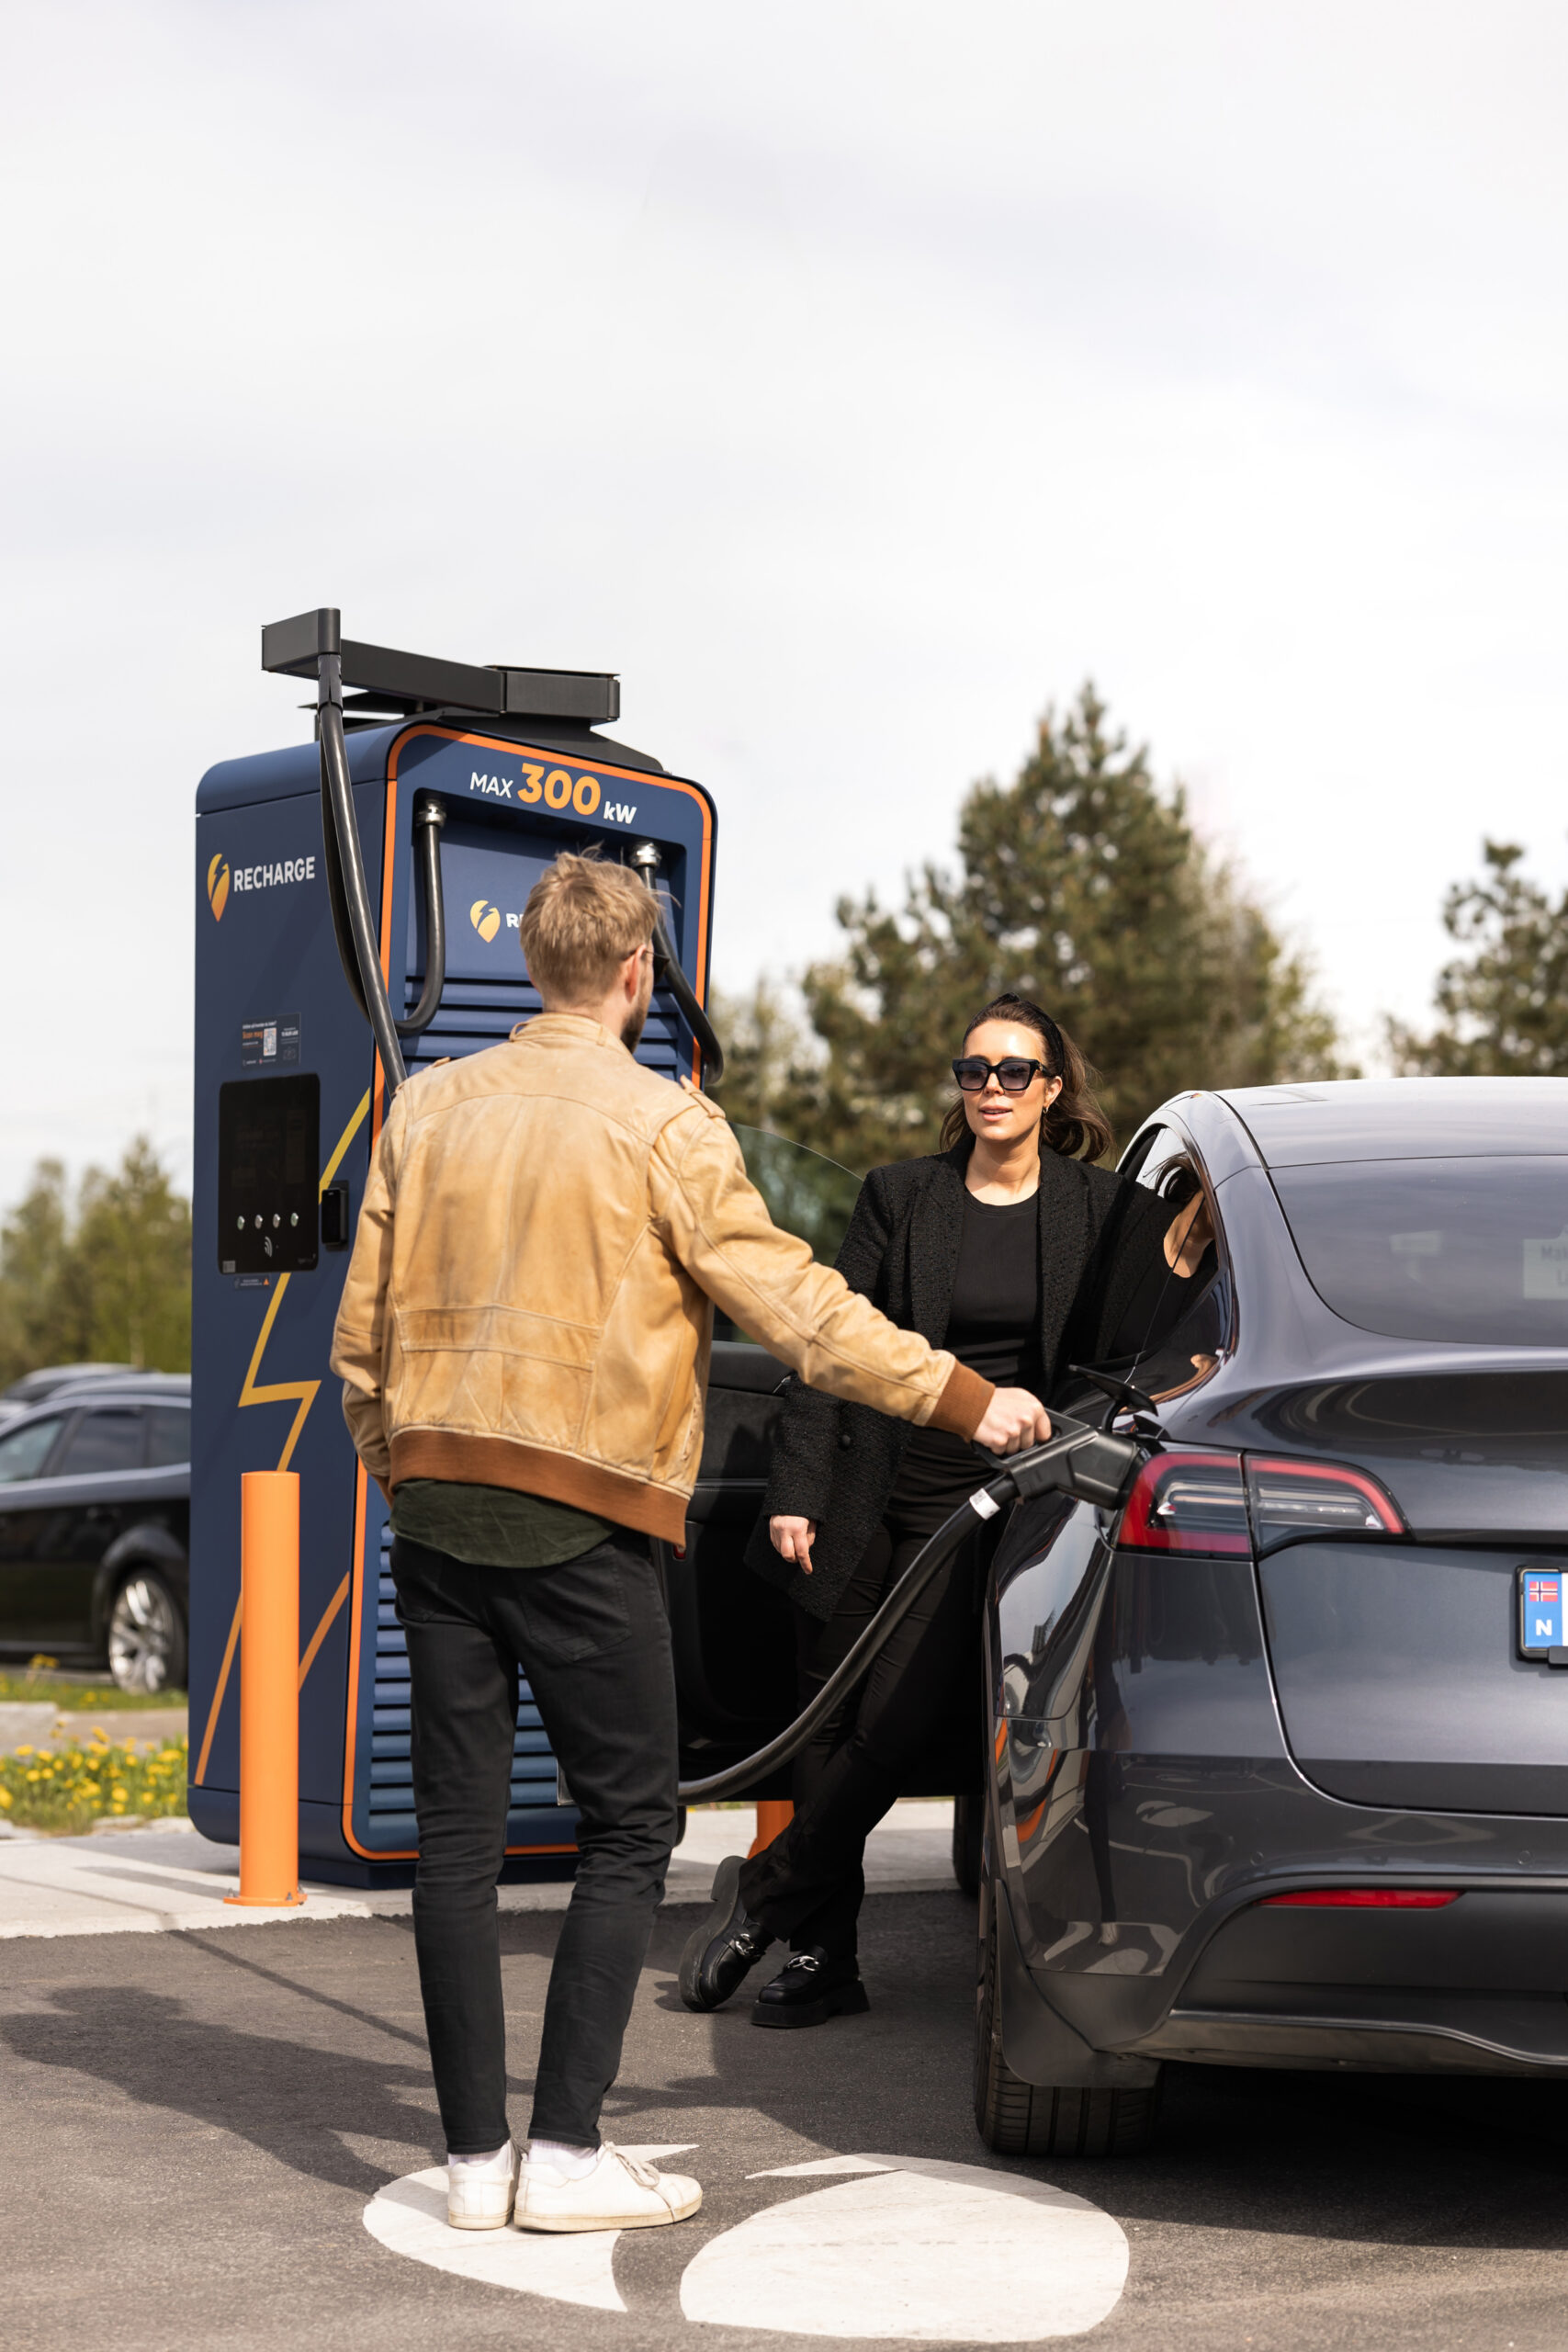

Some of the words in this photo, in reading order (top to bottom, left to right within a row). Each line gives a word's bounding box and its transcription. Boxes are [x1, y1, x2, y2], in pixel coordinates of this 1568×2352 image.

[469, 772, 513, 798] MAX
[517, 763, 601, 816] 300
[603, 801, 637, 824] kW
[233, 856, 315, 892] RECHARGE
[1536, 1619, 1552, 1636] N
